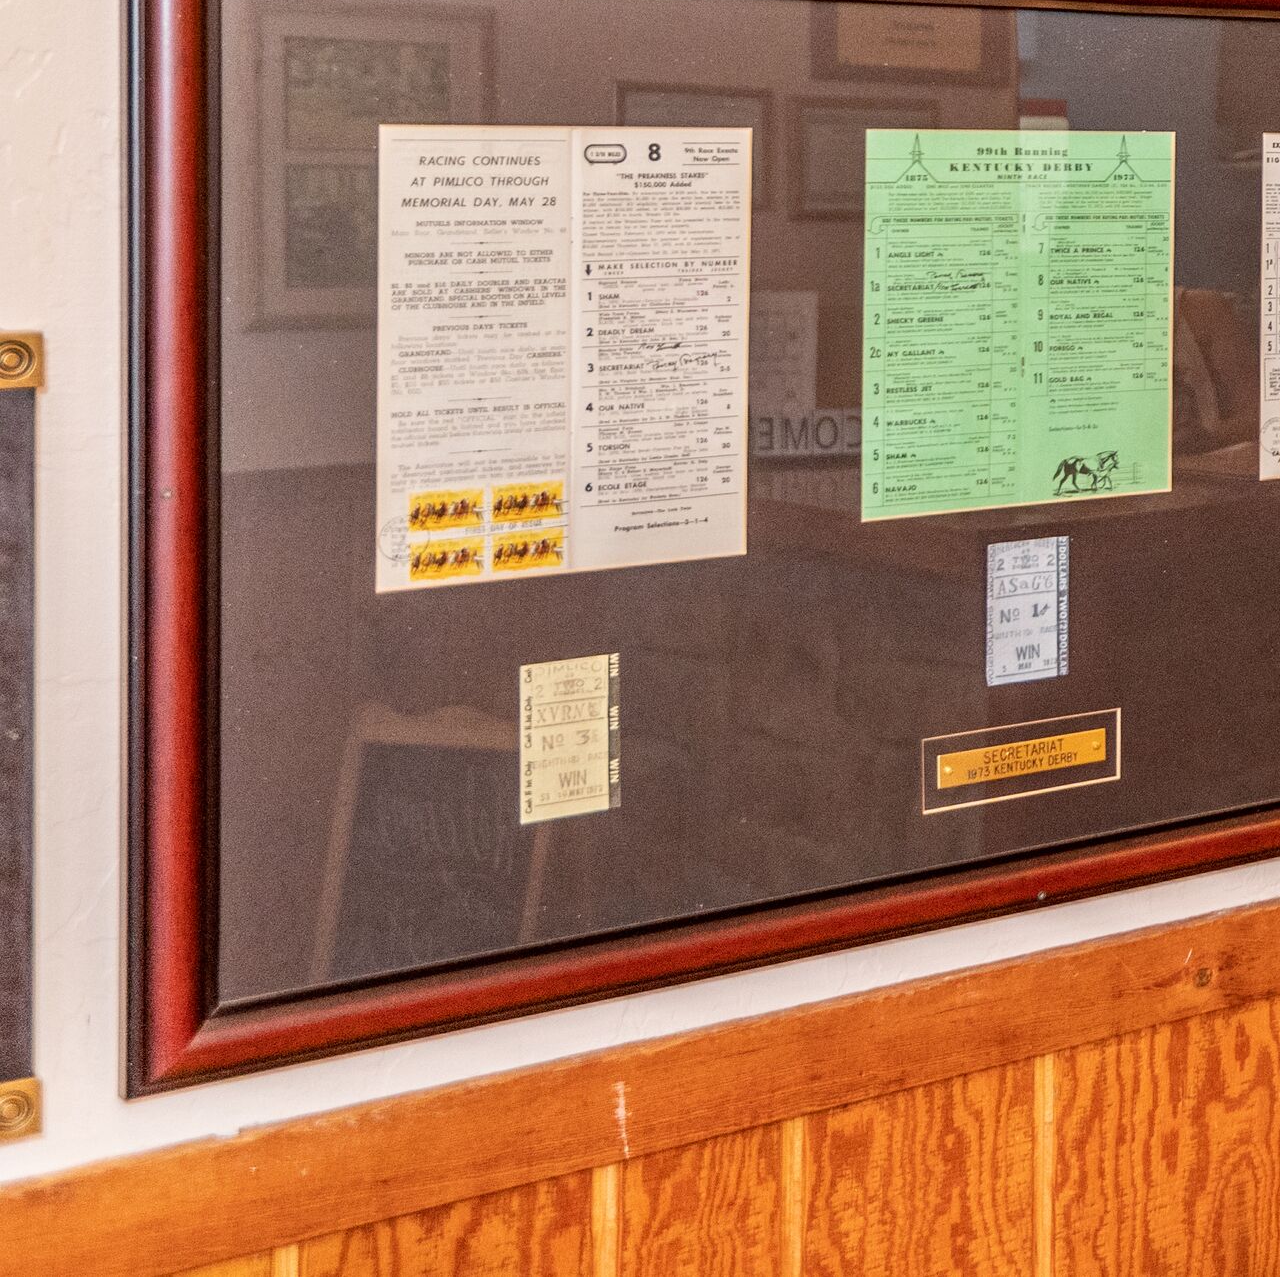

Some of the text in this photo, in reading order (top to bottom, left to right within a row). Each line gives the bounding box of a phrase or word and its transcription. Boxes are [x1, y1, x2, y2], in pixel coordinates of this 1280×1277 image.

[648, 143, 661, 161] 8
[977, 147, 1068, 157] 99th Running
[419, 156, 541, 166] RACING CONTINUES
[950, 163, 1093, 172] KENTUCKY DERBY
[410, 176, 549, 187] AT PIMLICO THROUGH
[906, 174, 928, 182] 1875
[401, 197, 466, 208] MEMORIAL
[508, 197, 535, 207] MAY
[542, 197, 557, 207] 28
[1038, 243, 1044, 254] 7
[630, 261, 678, 269] SELECTION
[701, 259, 738, 267] NUMBER
[888, 283, 934, 291] SECRETARIAT
[874, 314, 880, 325] 2
[1049, 312, 1072, 320] ROYAL
[1093, 311, 1114, 319] REGAL
[586, 328, 594, 337] 2
[598, 328, 625, 336] DEADLY
[1034, 341, 1043, 352] 10
[902, 349, 936, 357] GALLANT
[587, 363, 645, 373] 3 SECRETARIAT
[1034, 372, 1043, 384] 11
[873, 383, 880, 395] 3
[886, 386, 917, 394] RESTLESS
[586, 403, 594, 412] 4
[873, 416, 927, 427] 4 WARBUCKS
[586, 443, 631, 452] 5 TORSION
[873, 449, 879, 460] 5
[585, 481, 647, 492] 6 ECOLE ETAGE
[872, 482, 878, 494] 6
[614, 523, 644, 532] Program
[1016, 644, 1041, 661] WIN
[609, 653, 619, 677] WIN
[609, 706, 619, 729] WIN
[983, 738, 1064, 765] SECRETARIAT
[609, 759, 619, 783] WIN
[967, 752, 1078, 780] 1973 KENTUCKY DERBY
[558, 770, 588, 788] WIN
